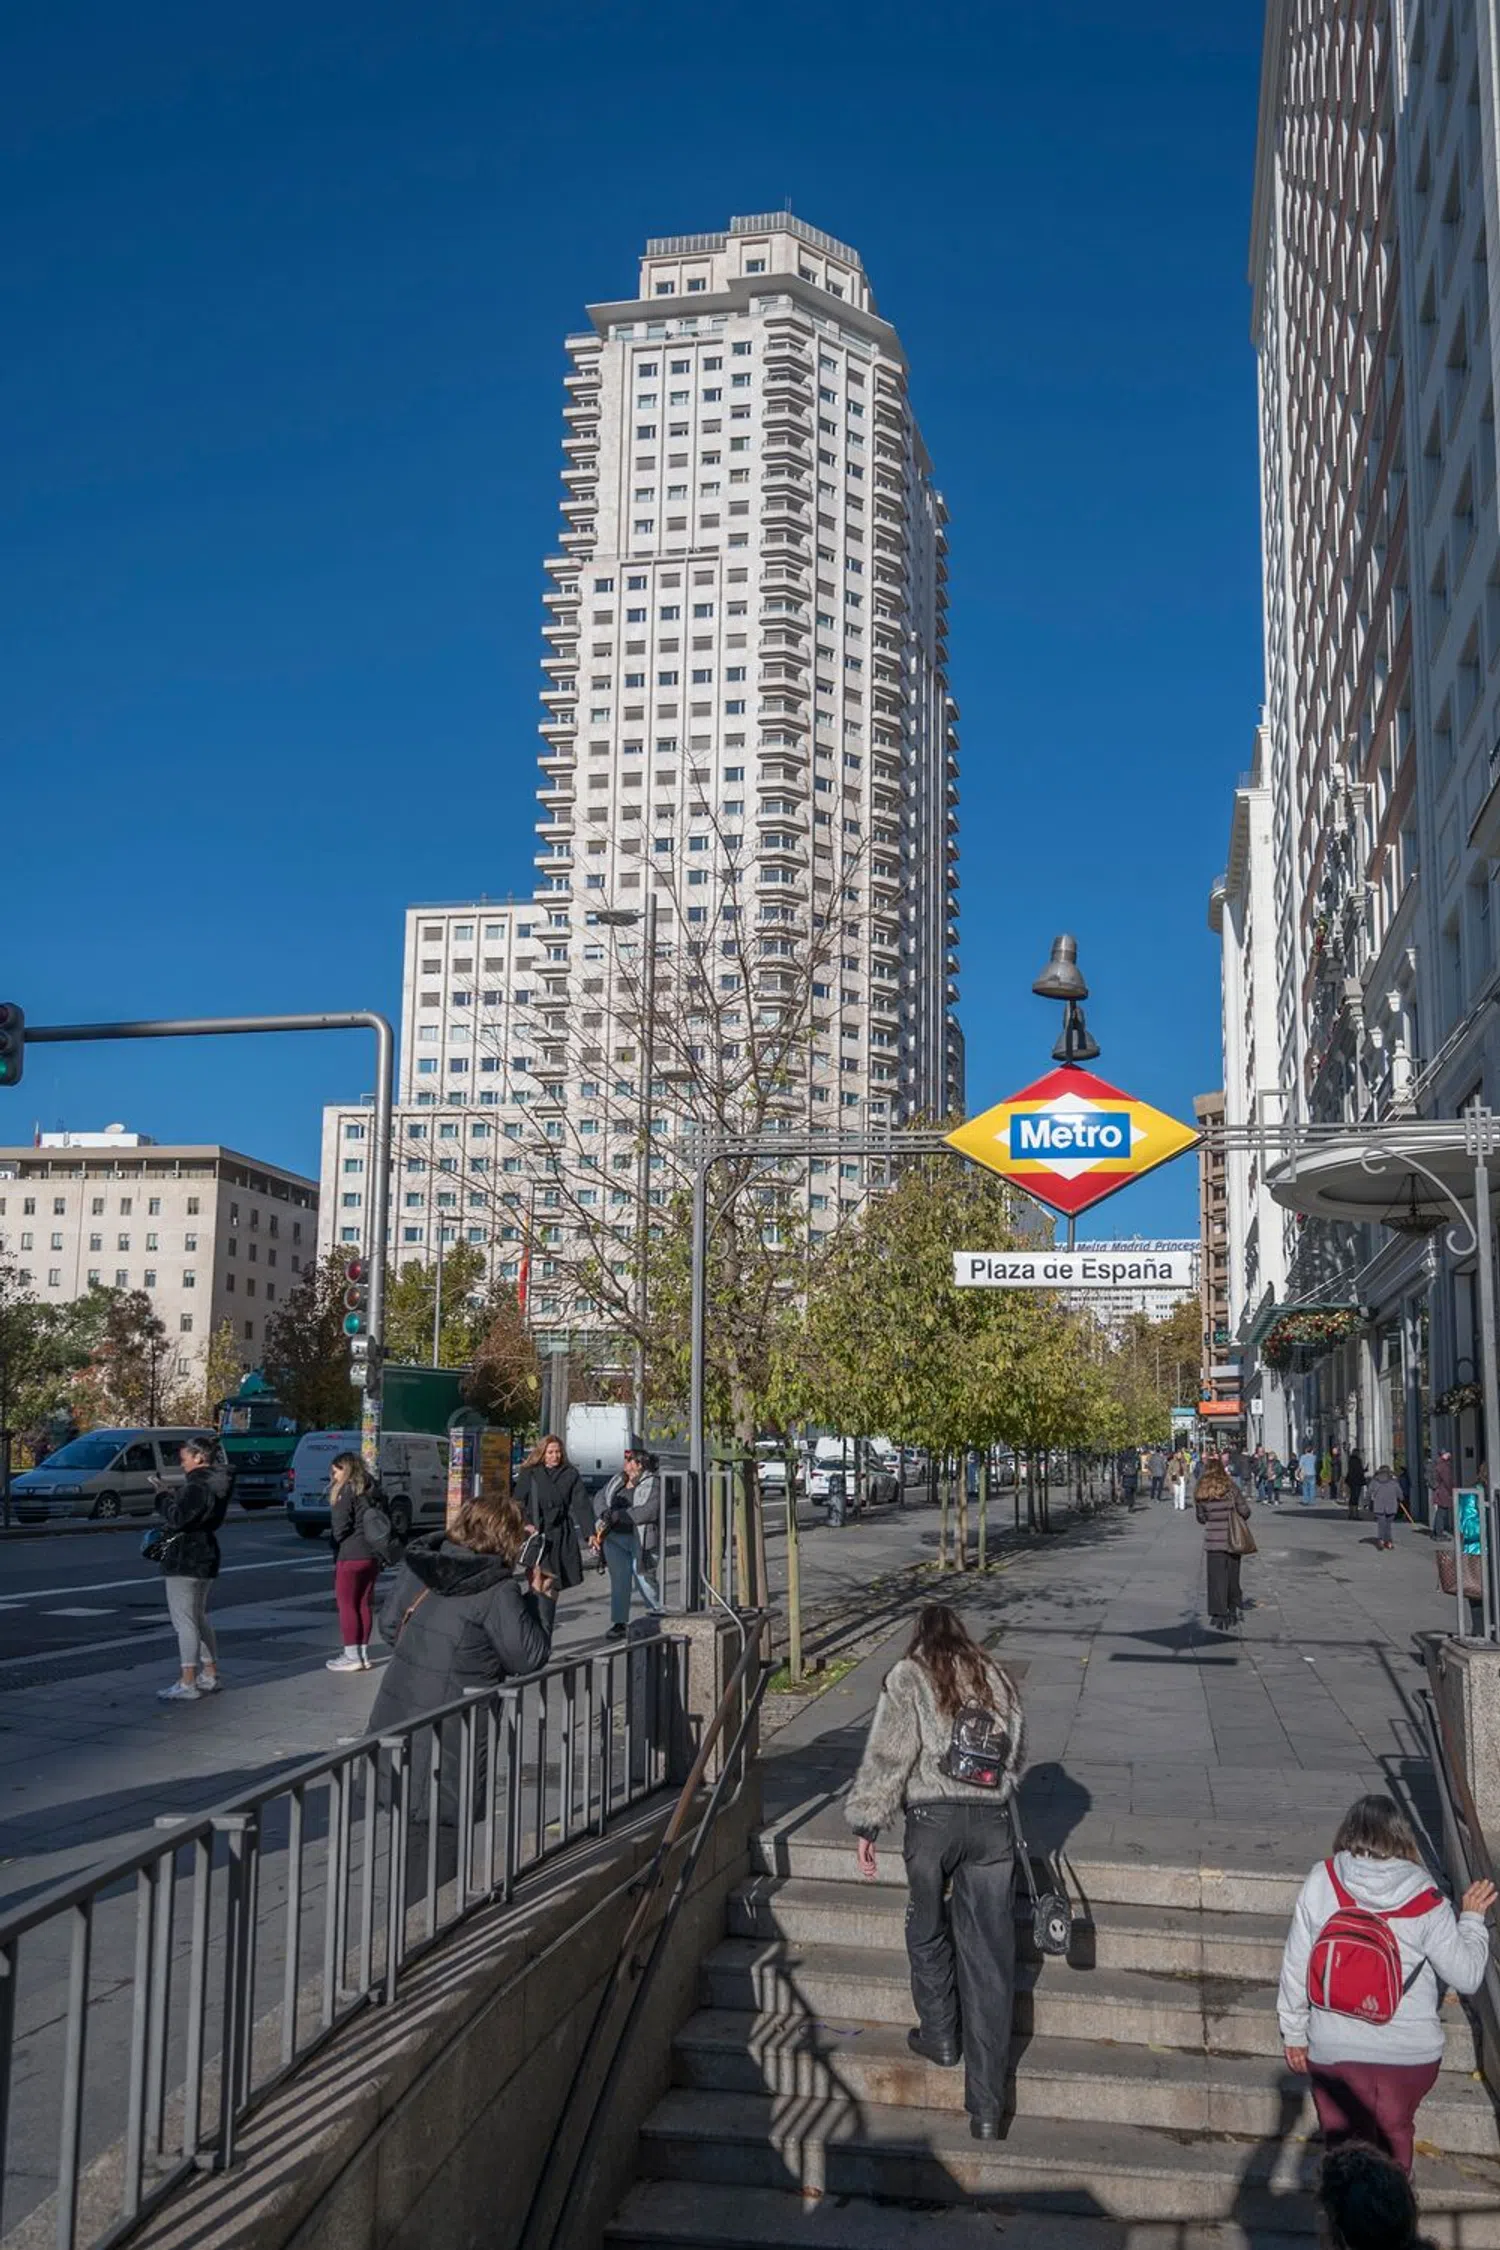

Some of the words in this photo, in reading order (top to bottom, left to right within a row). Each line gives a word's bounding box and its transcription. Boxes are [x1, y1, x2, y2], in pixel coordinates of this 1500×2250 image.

[1020, 1119, 1123, 1149] Metro
[1111, 1241, 1151, 1252] Madrid
[970, 1258, 1036, 1280] Plaza
[1043, 1258, 1073, 1280] de
[1082, 1257, 1173, 1284] España
